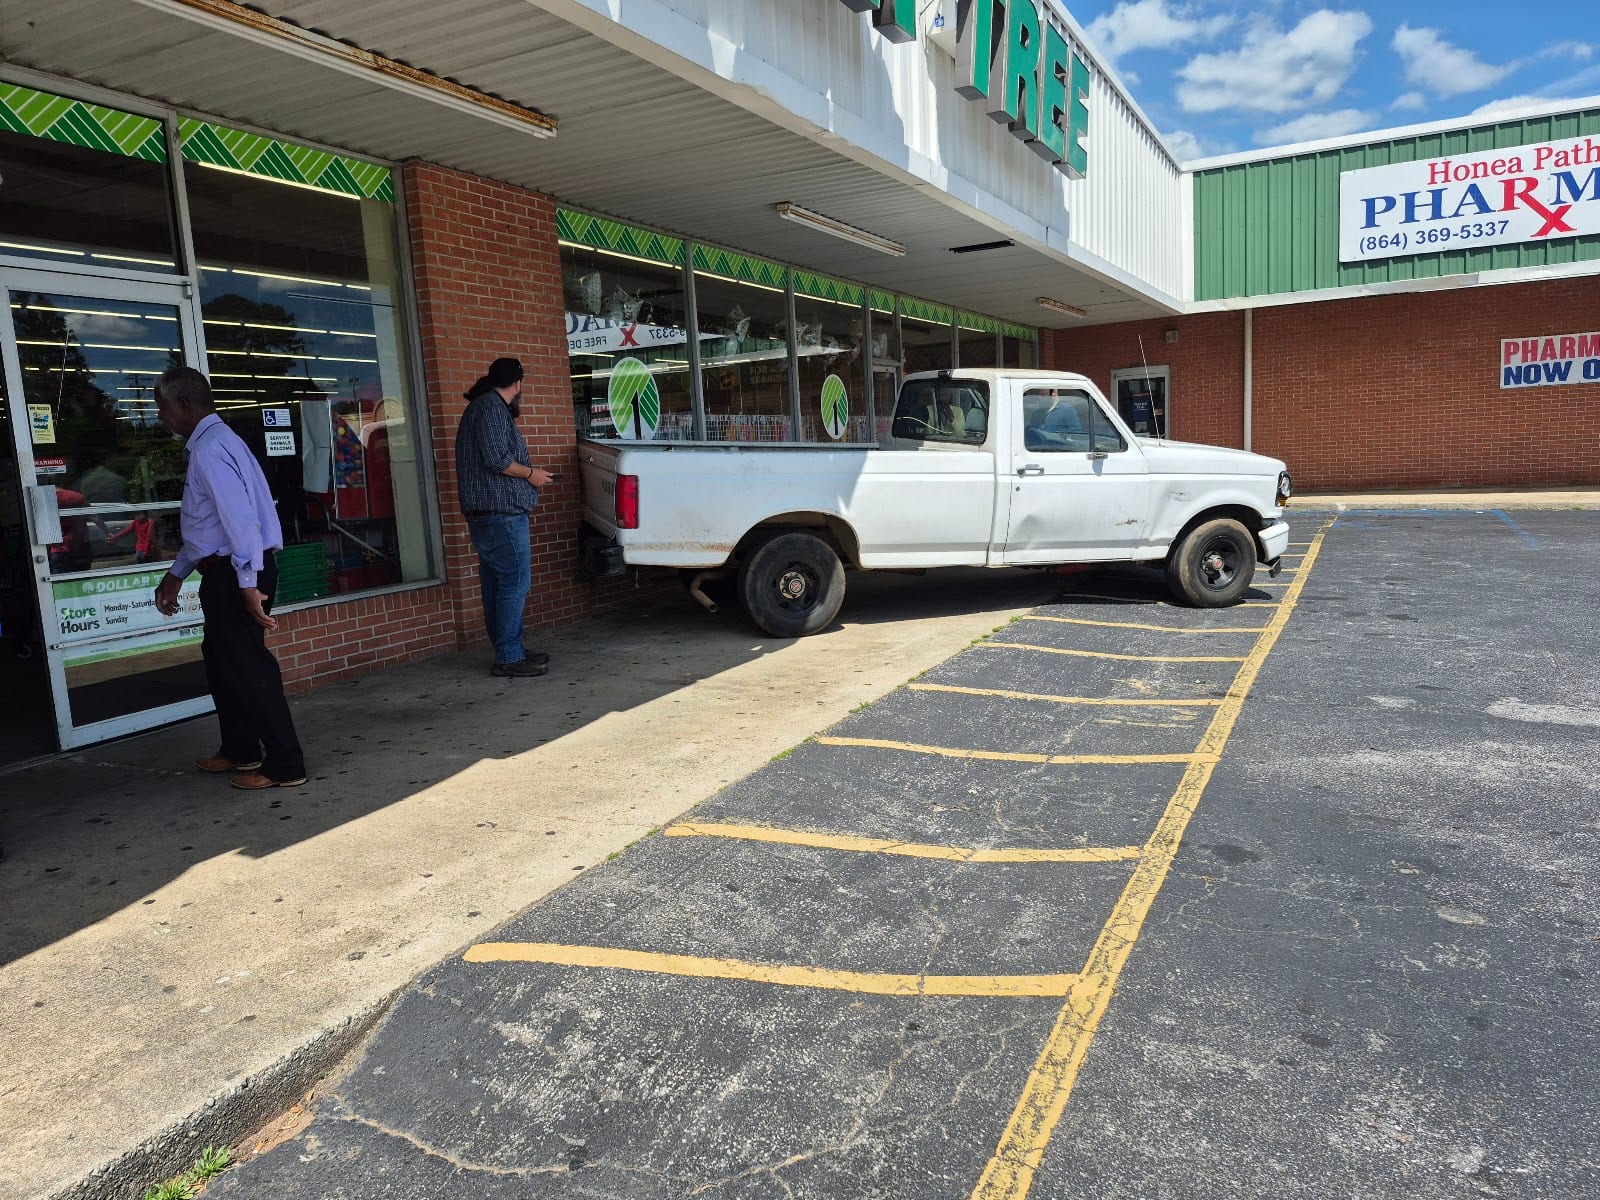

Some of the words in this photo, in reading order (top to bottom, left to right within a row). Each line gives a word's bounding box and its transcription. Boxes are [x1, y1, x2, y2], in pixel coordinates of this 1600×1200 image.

[1427, 156, 1523, 185] Honea
[1533, 139, 1600, 170] Path
[1359, 232, 1408, 254] (864)
[1415, 220, 1509, 244] 369-5337
[1503, 334, 1600, 365] PHARM
[1503, 361, 1573, 386] NOW
[96, 576, 150, 593] DOLLAR
[60, 606, 97, 620] Store
[104, 599, 156, 613] Monday-Saturda
[60, 618, 100, 635] Hours
[105, 615, 129, 625] Sunday
